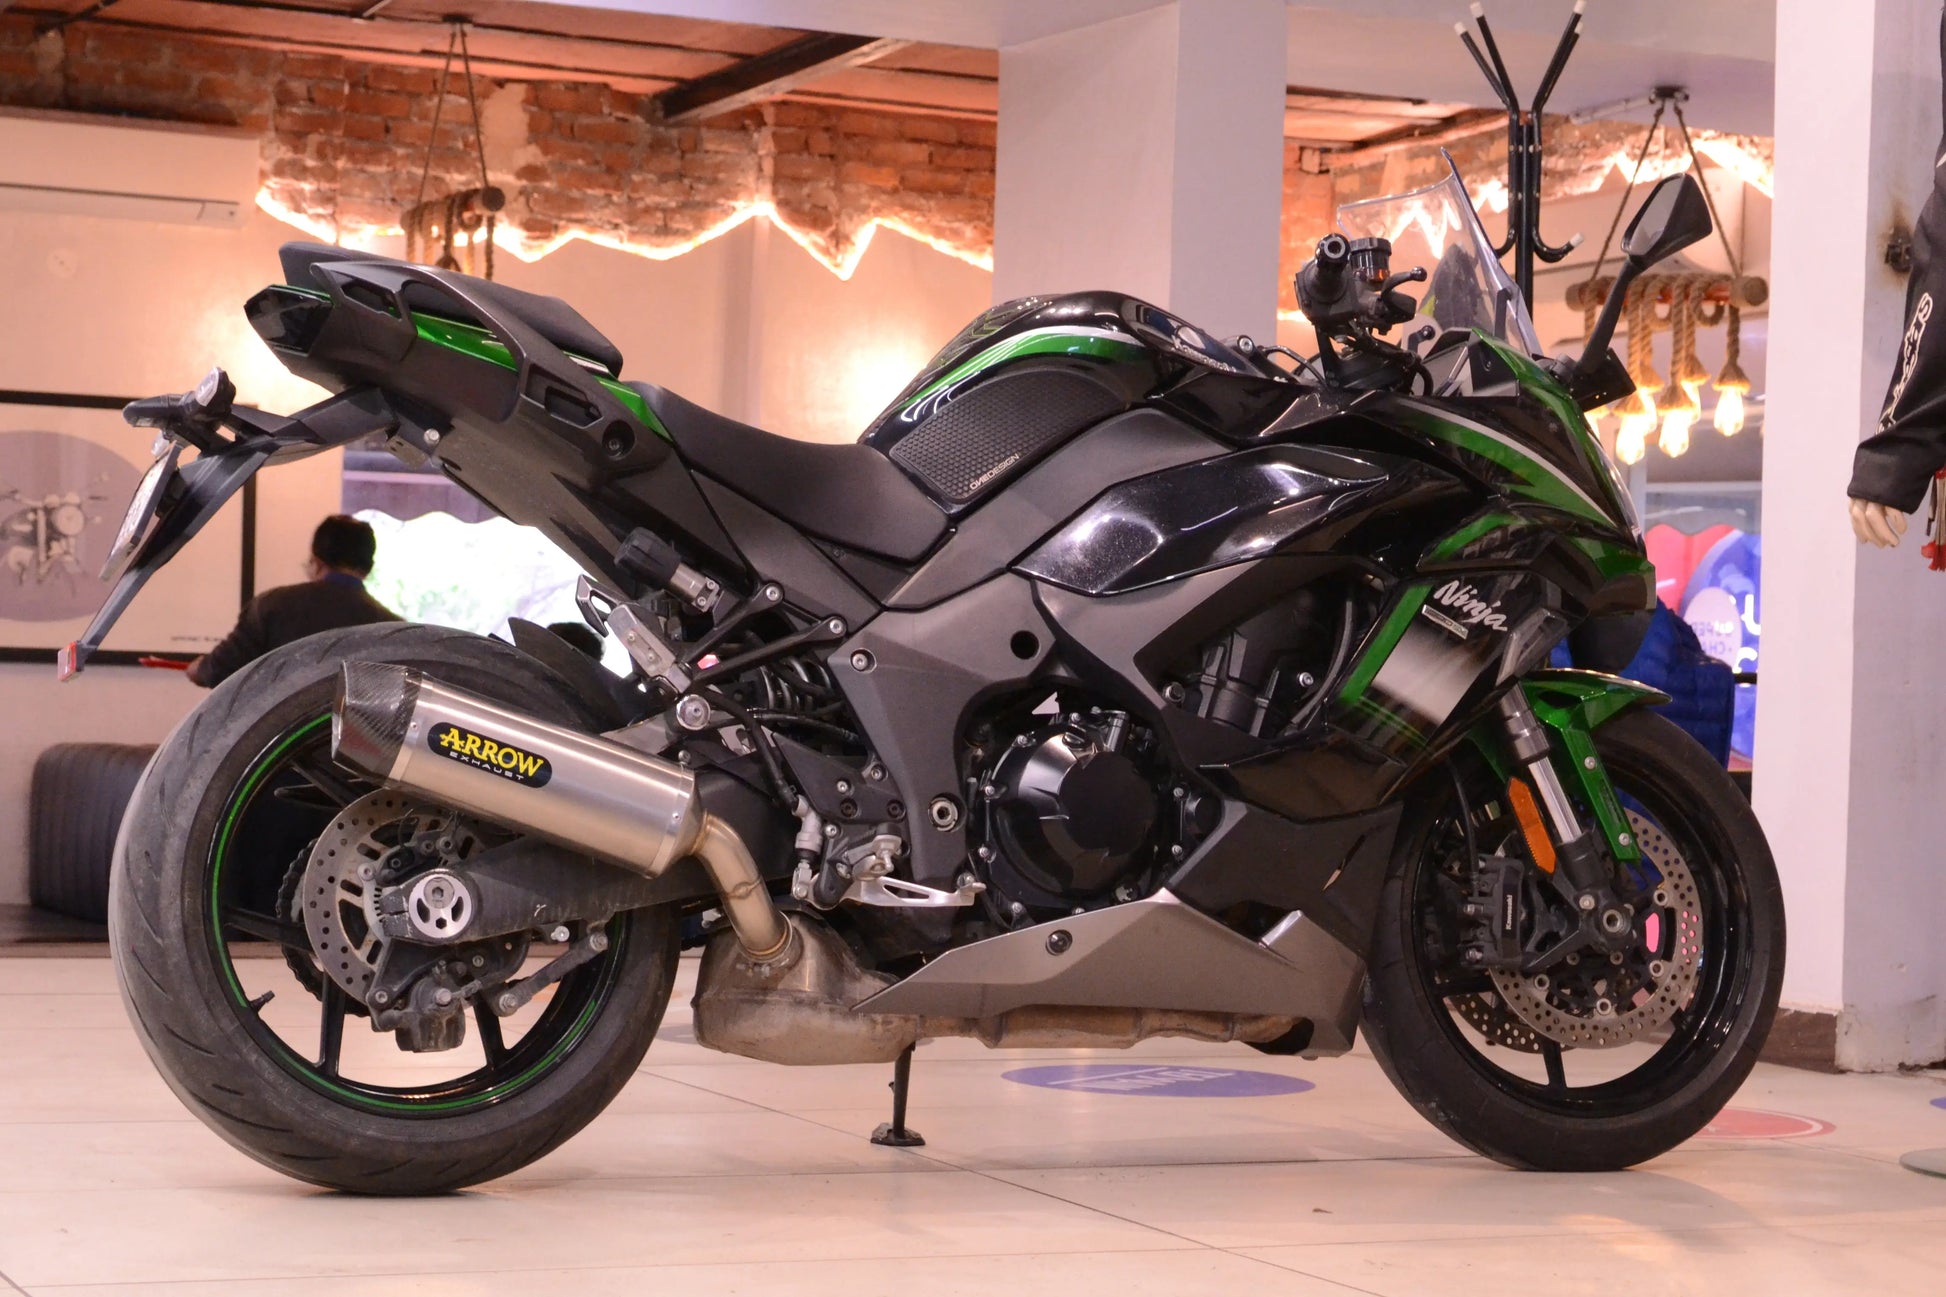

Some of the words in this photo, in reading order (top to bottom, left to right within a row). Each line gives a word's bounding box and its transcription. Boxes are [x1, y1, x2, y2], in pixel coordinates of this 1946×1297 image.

[1433, 580, 1508, 632] Ninja
[439, 727, 545, 777] ARROW
[449, 750, 525, 781] EXHAUST
